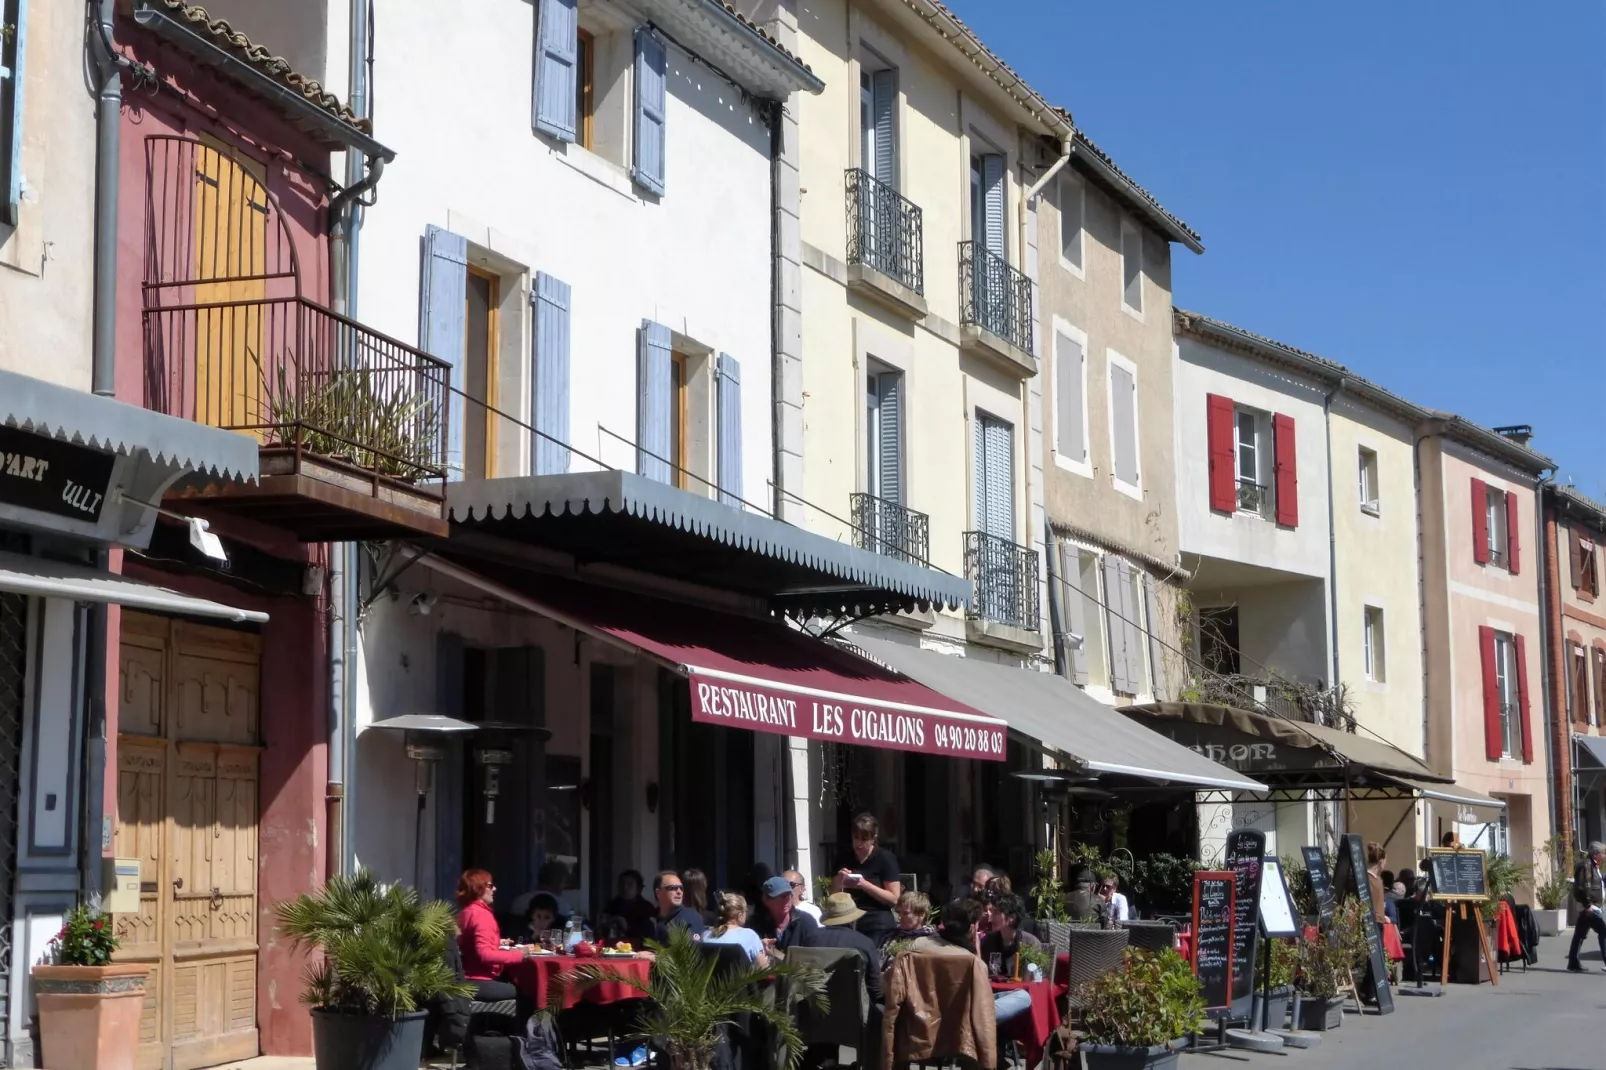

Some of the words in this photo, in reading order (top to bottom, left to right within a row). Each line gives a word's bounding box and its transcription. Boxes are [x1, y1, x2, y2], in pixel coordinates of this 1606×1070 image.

[62, 479, 102, 515] ULLI
[697, 682, 798, 728] RESTAURANT
[812, 702, 844, 737] LES
[850, 708, 925, 747] CIGALONS
[934, 723, 948, 748] 04
[948, 725, 962, 750] 90
[963, 727, 977, 751] 20
[977, 729, 989, 754] 88
[990, 731, 1003, 754] 03
